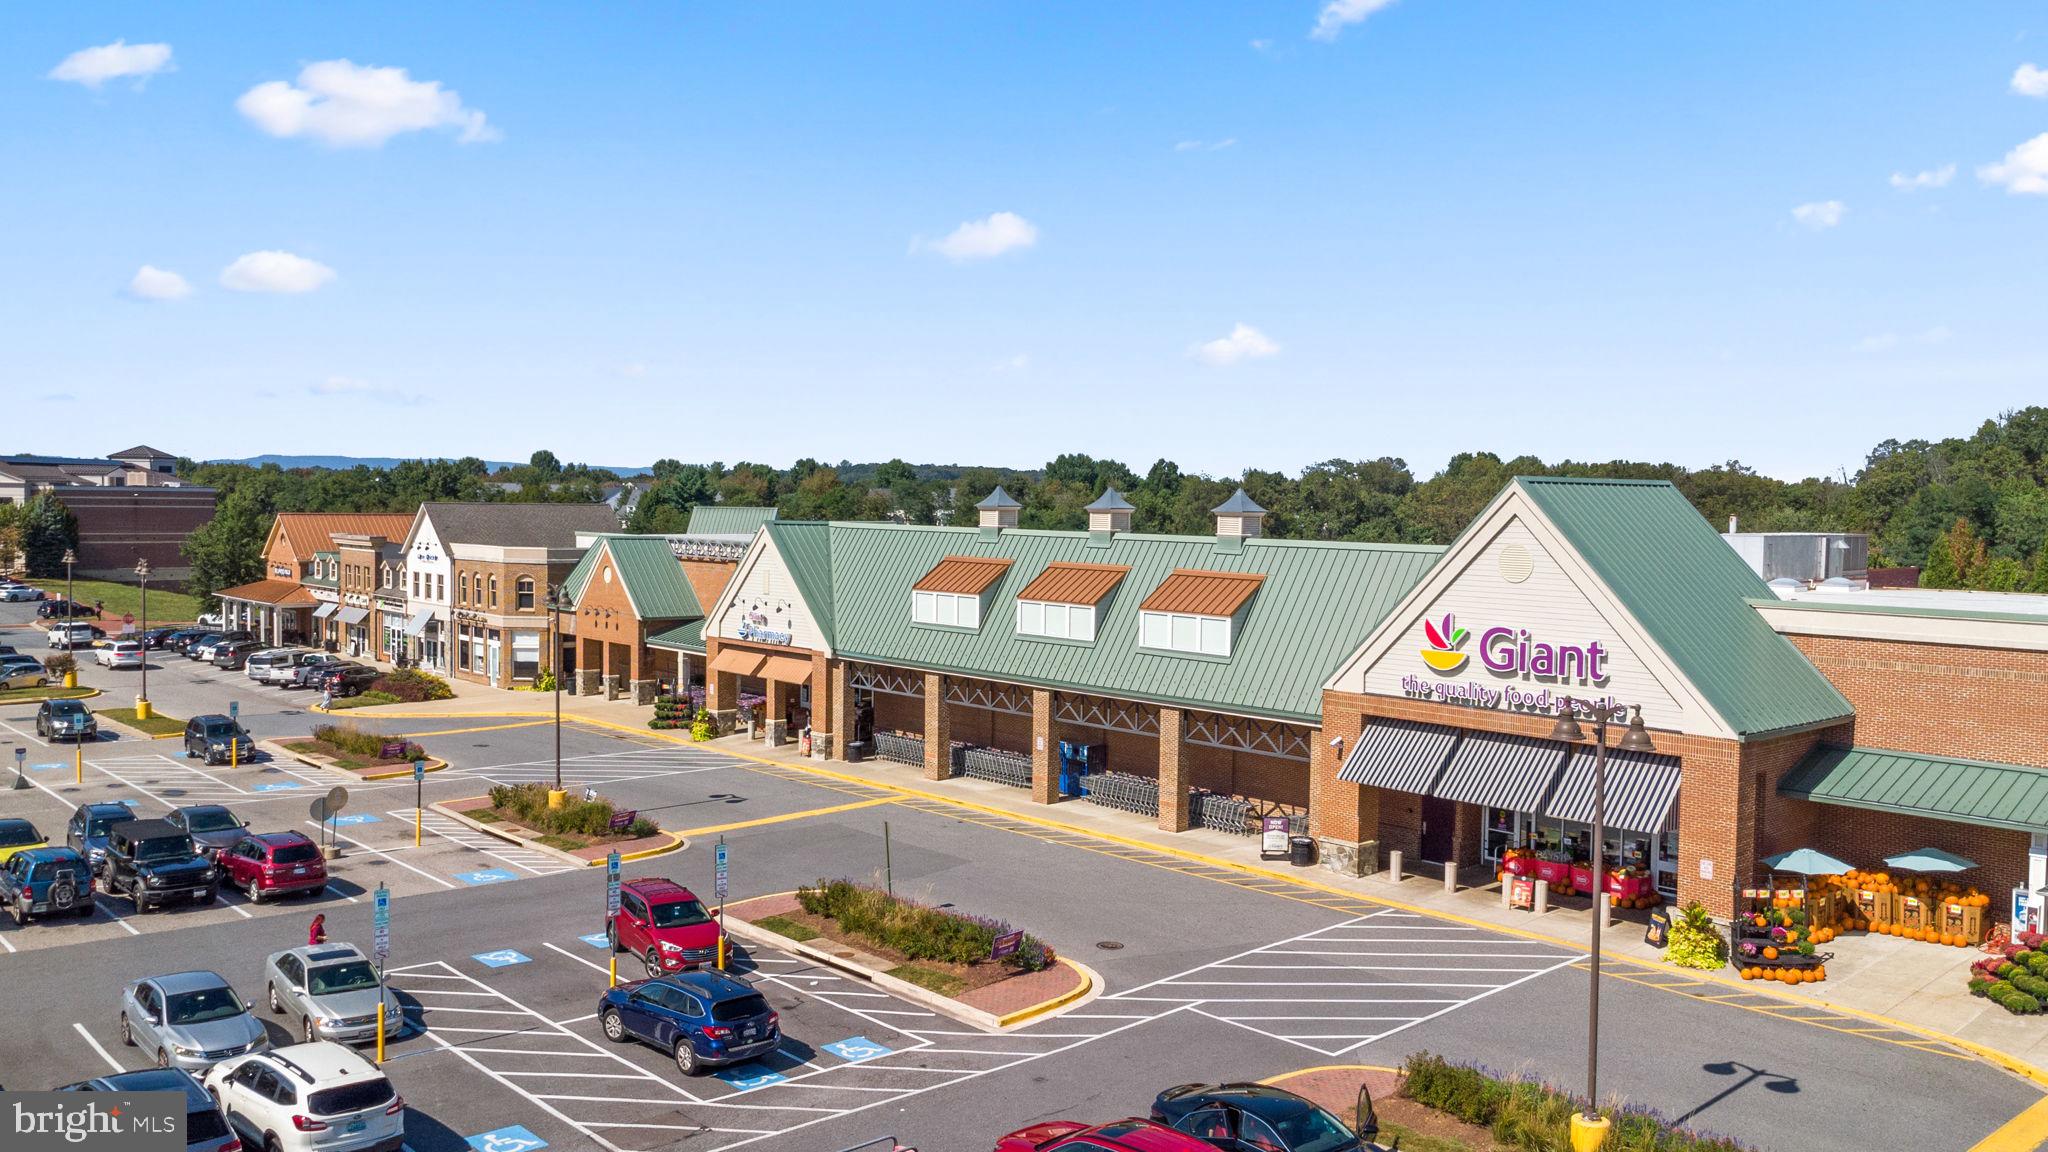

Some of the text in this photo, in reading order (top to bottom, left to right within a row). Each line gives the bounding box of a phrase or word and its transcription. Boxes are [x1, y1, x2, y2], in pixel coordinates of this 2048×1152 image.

[1479, 626, 1606, 682] Giant
[1402, 674, 1625, 717] the quality food peole
